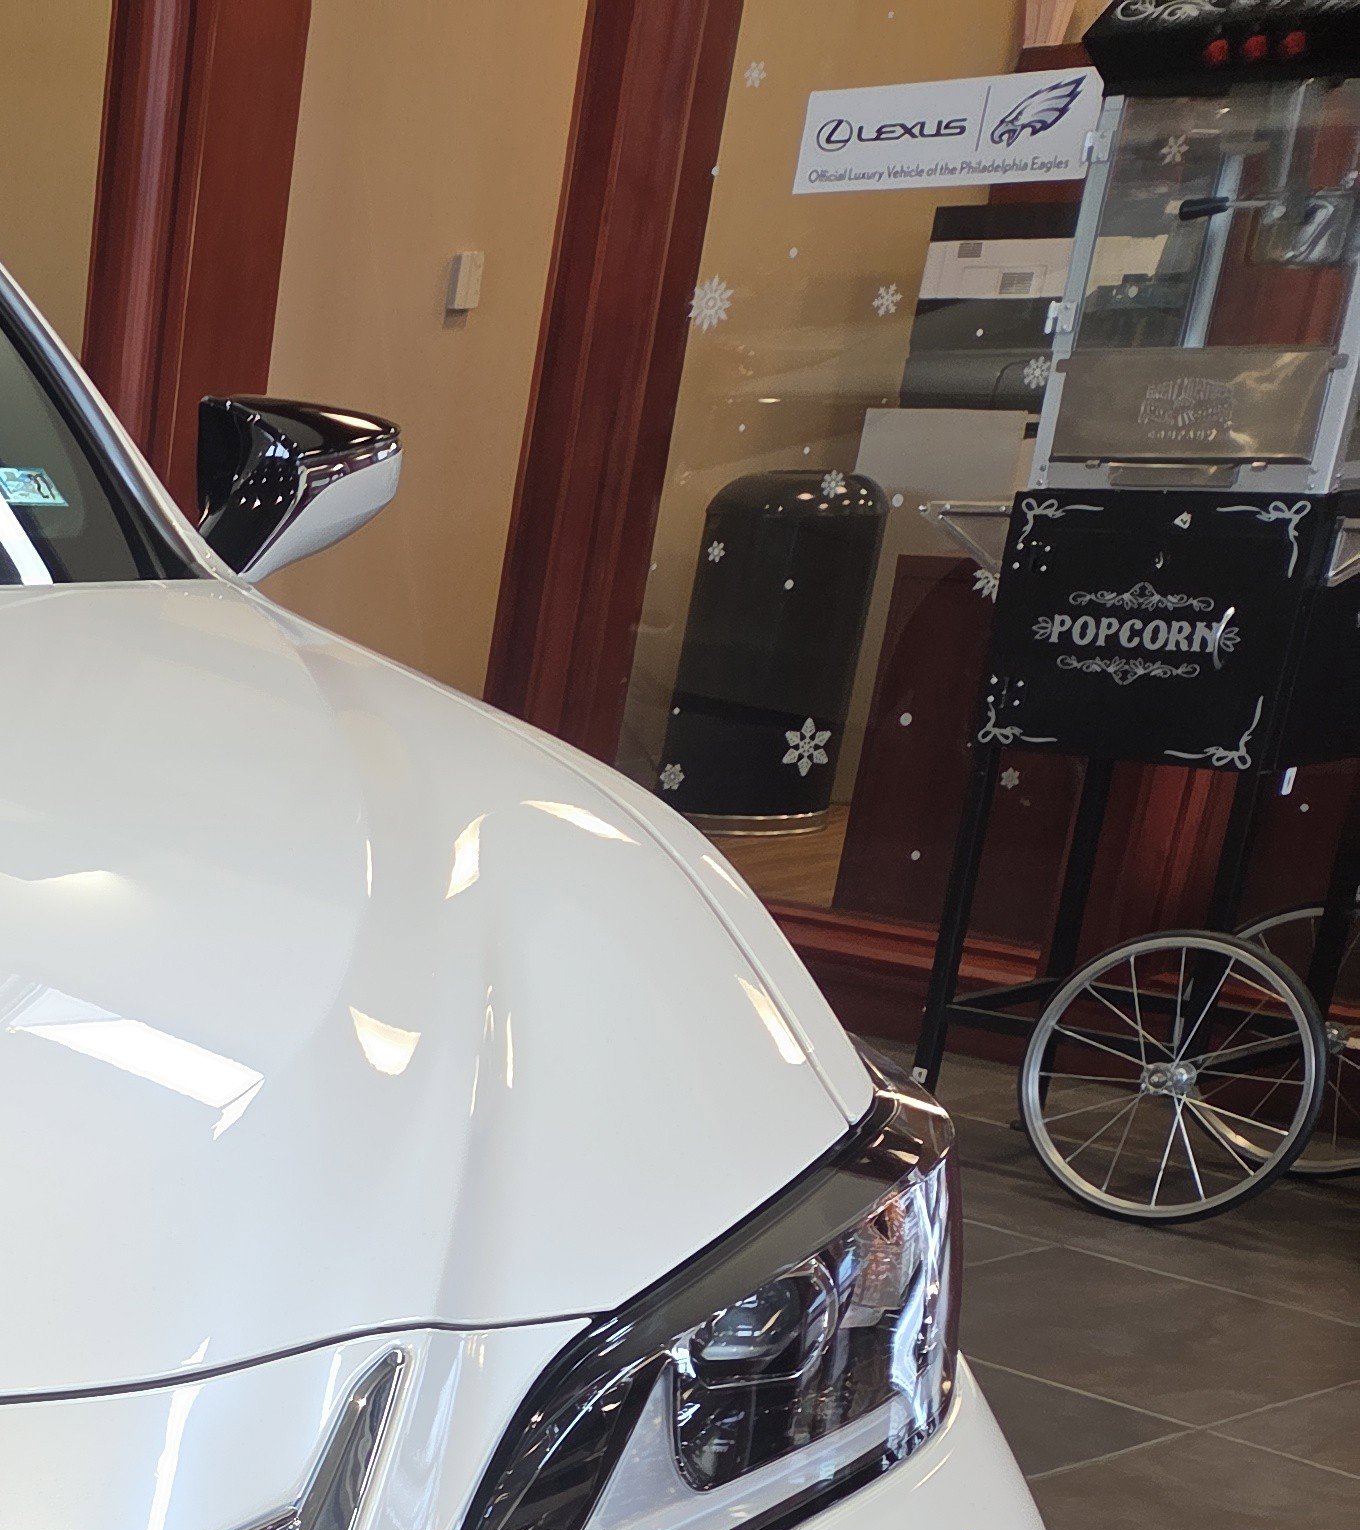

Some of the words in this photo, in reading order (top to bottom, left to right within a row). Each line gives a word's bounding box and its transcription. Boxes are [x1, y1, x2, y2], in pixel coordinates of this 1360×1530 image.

[857, 117, 968, 143] LEXUS
[808, 168, 848, 184] Official
[848, 167, 884, 182] Luxury
[887, 163, 925, 179] Vehicle
[926, 161, 940, 177] of
[940, 162, 958, 176] the
[960, 157, 1029, 175] Philadelphia
[1030, 155, 1069, 173] Eagles
[1048, 613, 1220, 653] POPCORN
